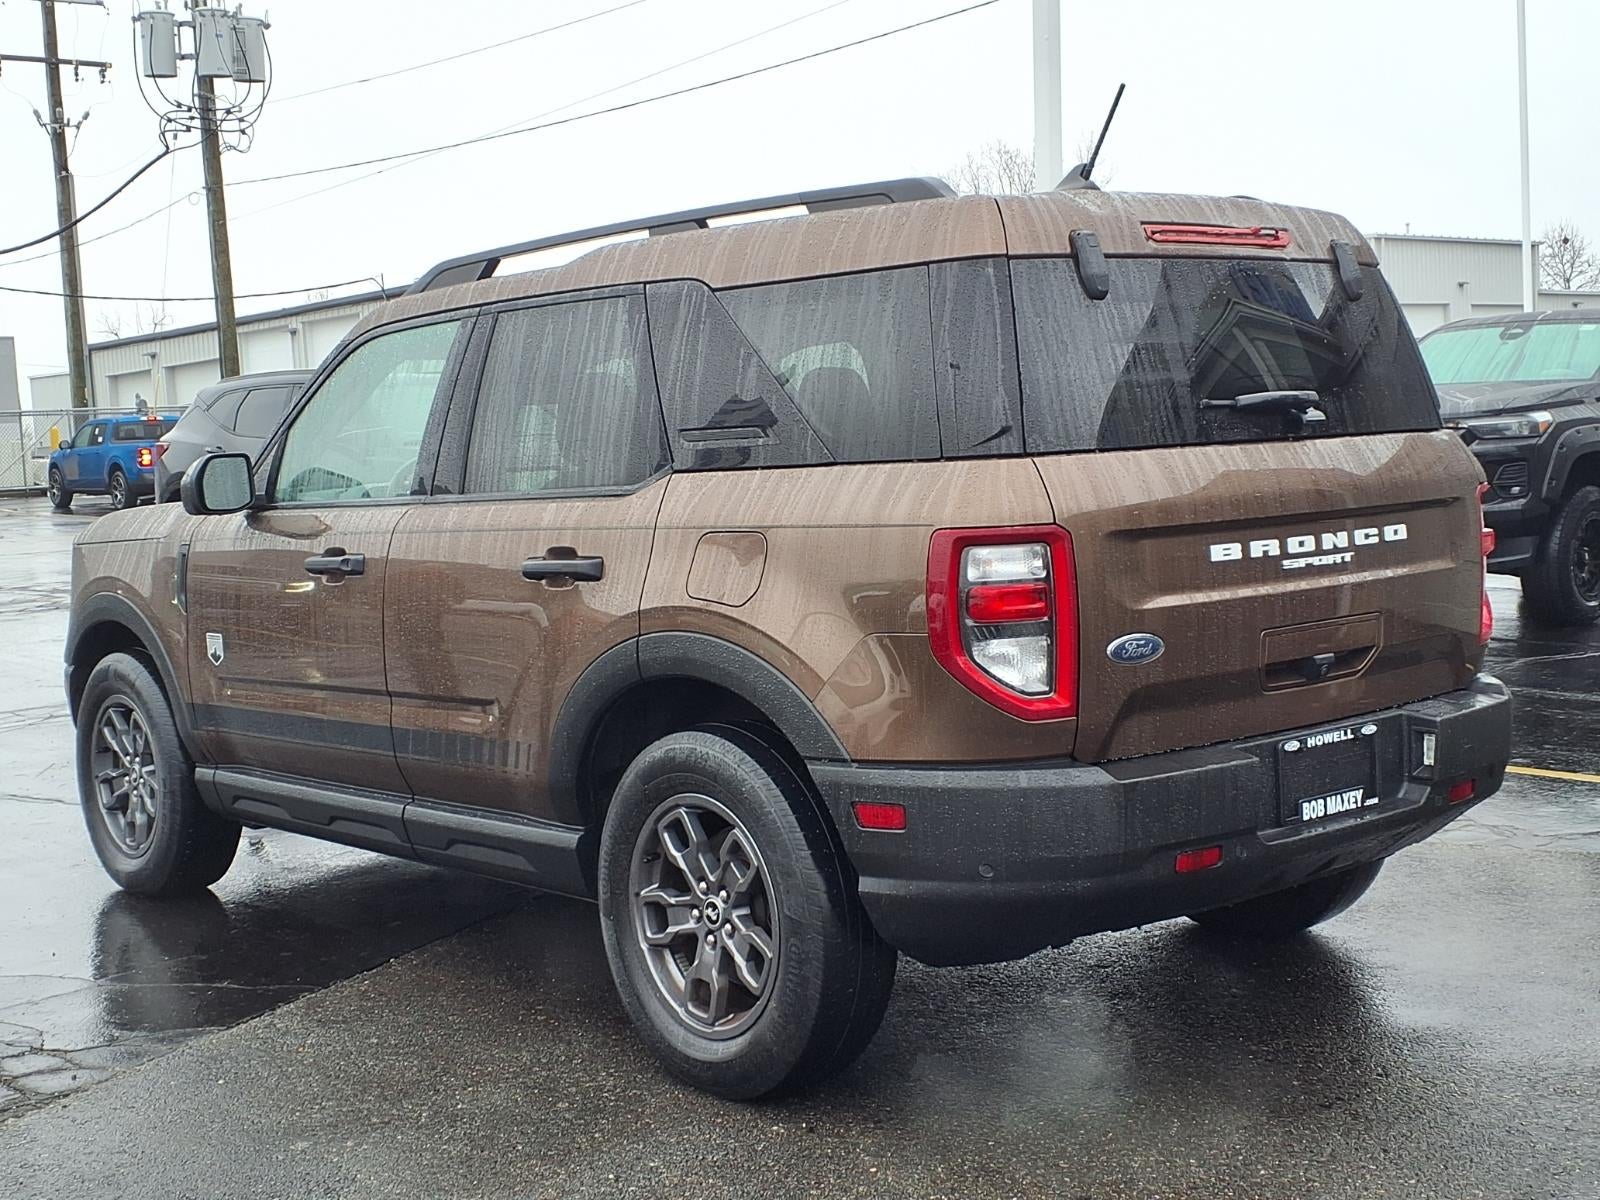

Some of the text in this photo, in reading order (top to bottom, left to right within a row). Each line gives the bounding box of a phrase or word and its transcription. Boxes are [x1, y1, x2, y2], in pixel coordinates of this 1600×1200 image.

[1209, 523, 1408, 562] BRONCO
[1280, 551, 1355, 570] SPORT
[1122, 640, 1154, 658] Ford
[1306, 728, 1355, 748] HOWELL
[1302, 798, 1325, 821] BOB
[1326, 789, 1364, 815] MAXEY
